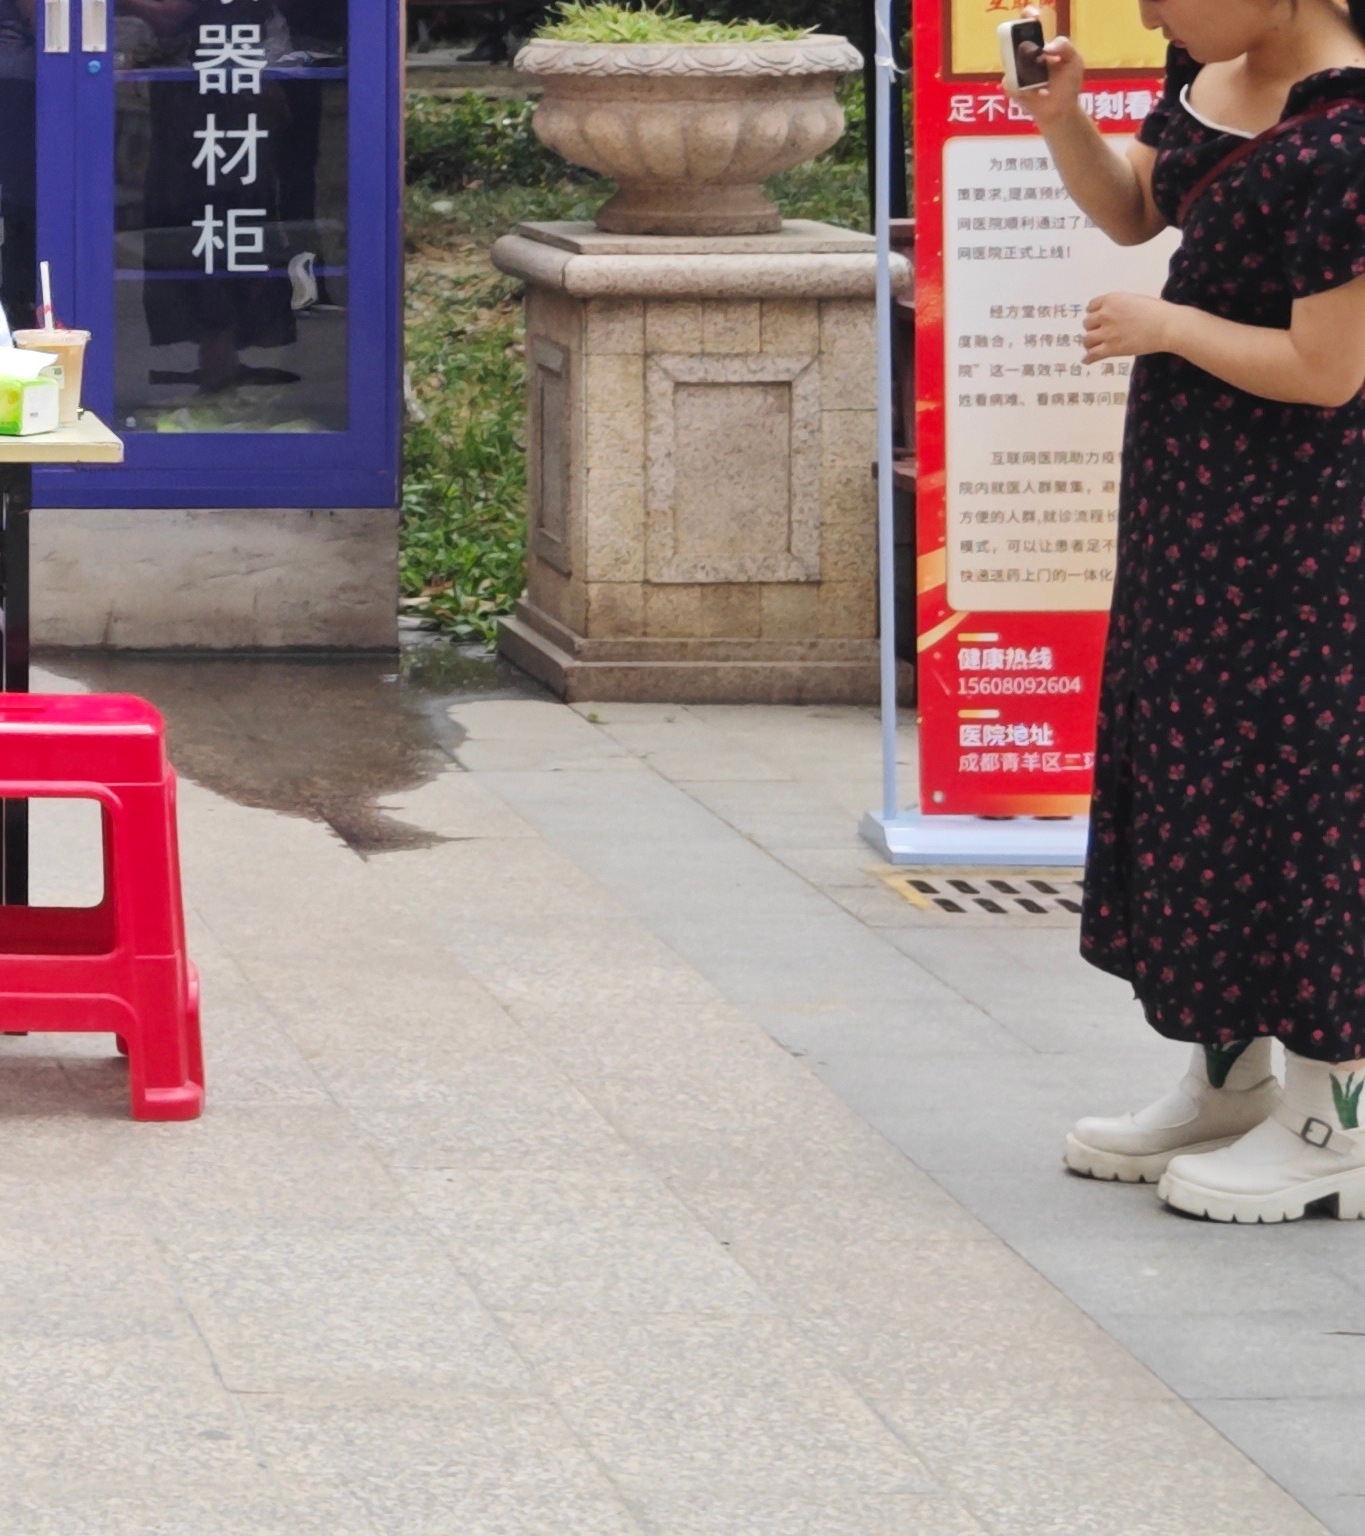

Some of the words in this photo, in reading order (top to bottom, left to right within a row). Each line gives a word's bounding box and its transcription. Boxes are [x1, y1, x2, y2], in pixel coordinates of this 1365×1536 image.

[957, 646, 1053, 672] 健康热线
[957, 675, 1083, 696] 15608092604
[959, 721, 1055, 748] 医院地址
